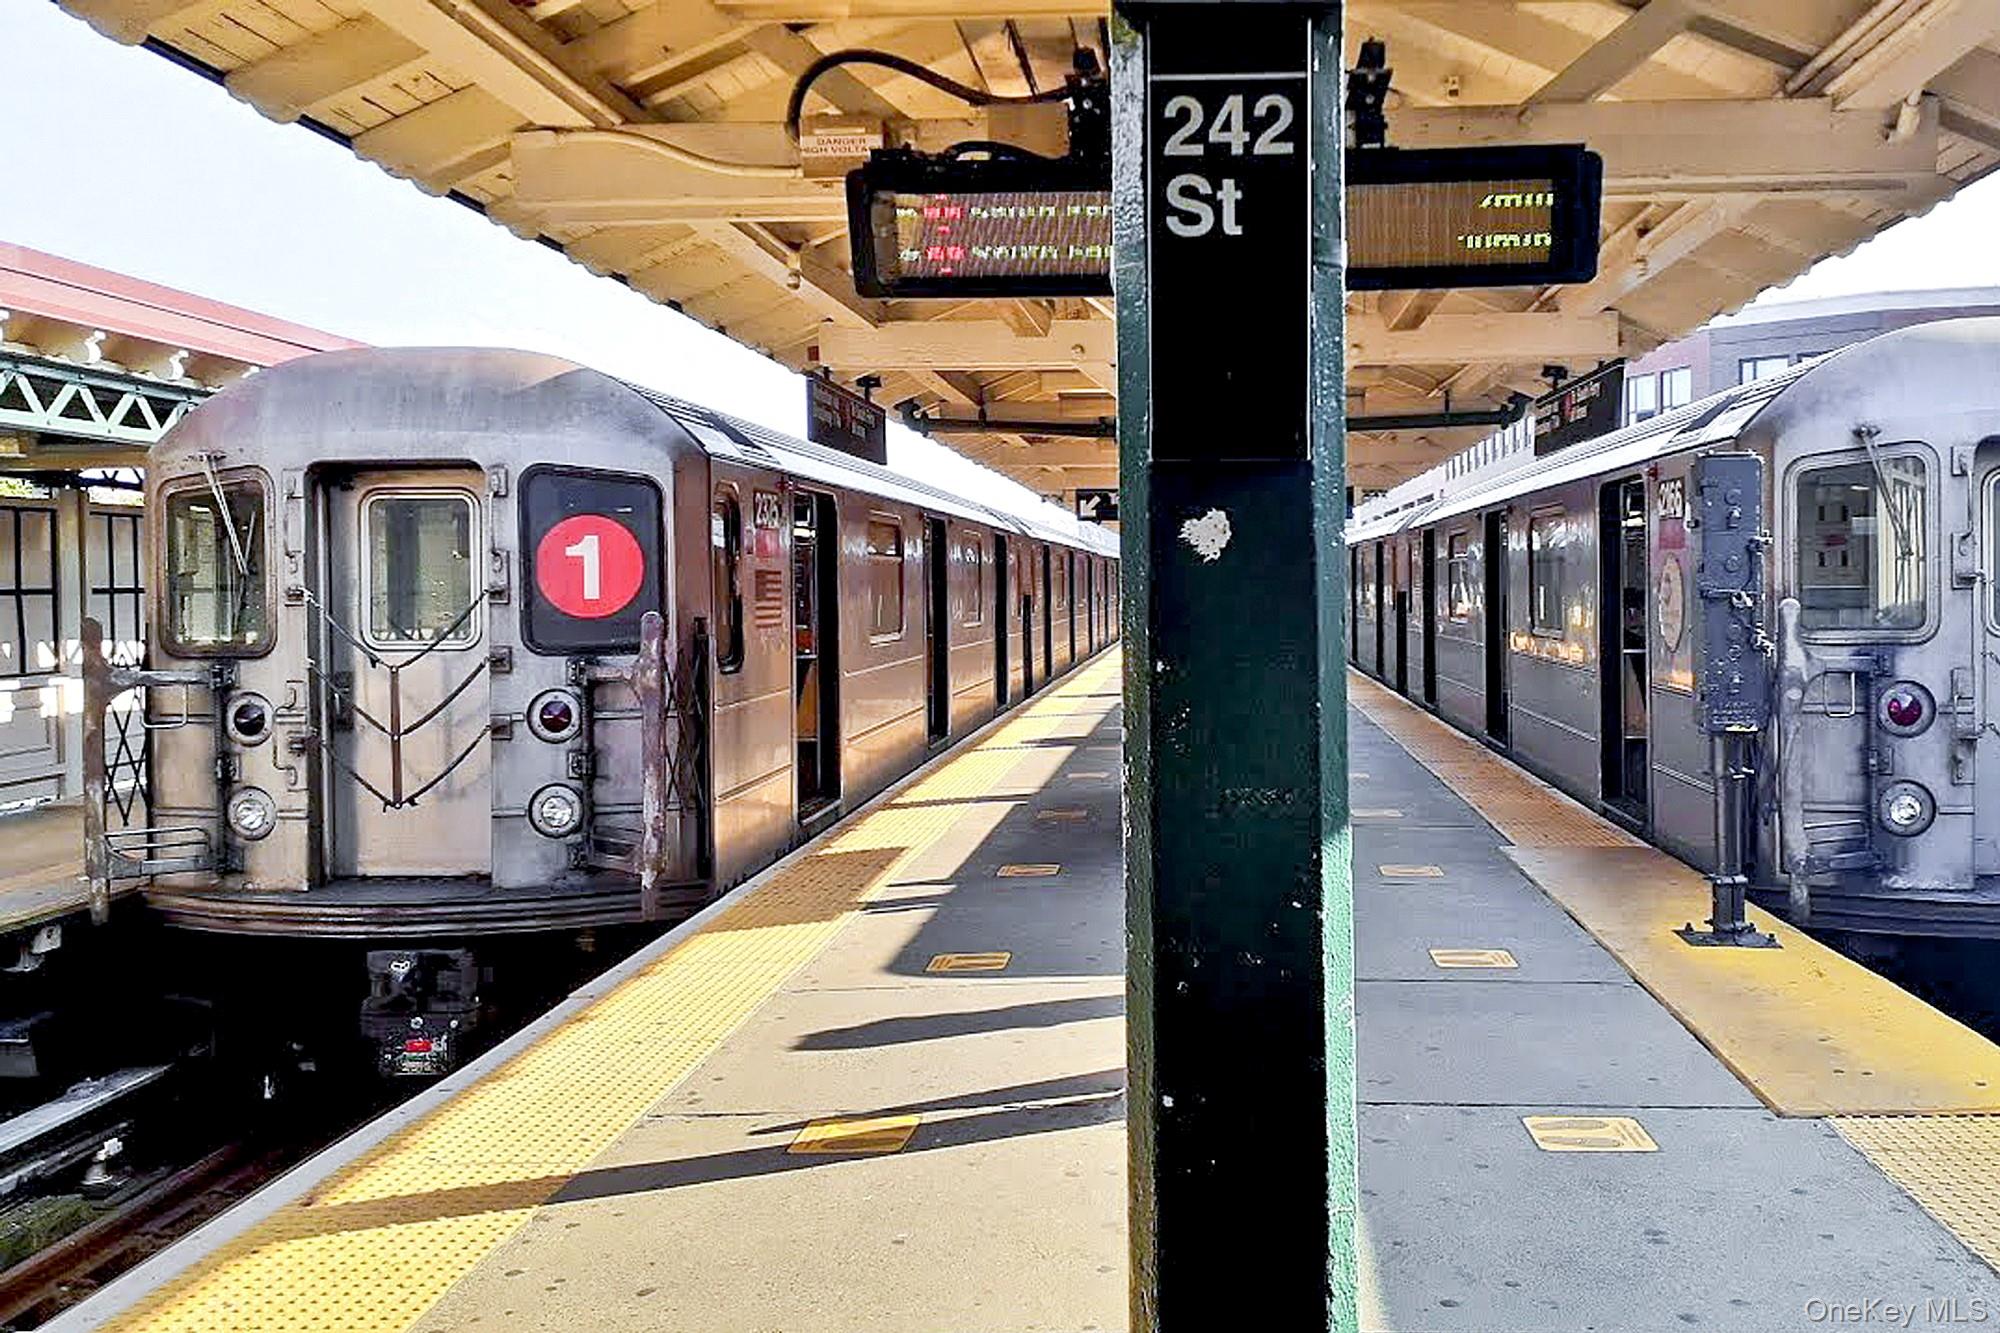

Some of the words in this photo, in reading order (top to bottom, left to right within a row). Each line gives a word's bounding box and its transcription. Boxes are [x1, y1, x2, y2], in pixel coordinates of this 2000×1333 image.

[816, 137, 867, 146] DANGER
[1163, 93, 1295, 156] 242
[1165, 173, 1244, 238] St
[564, 534, 601, 600] 1
